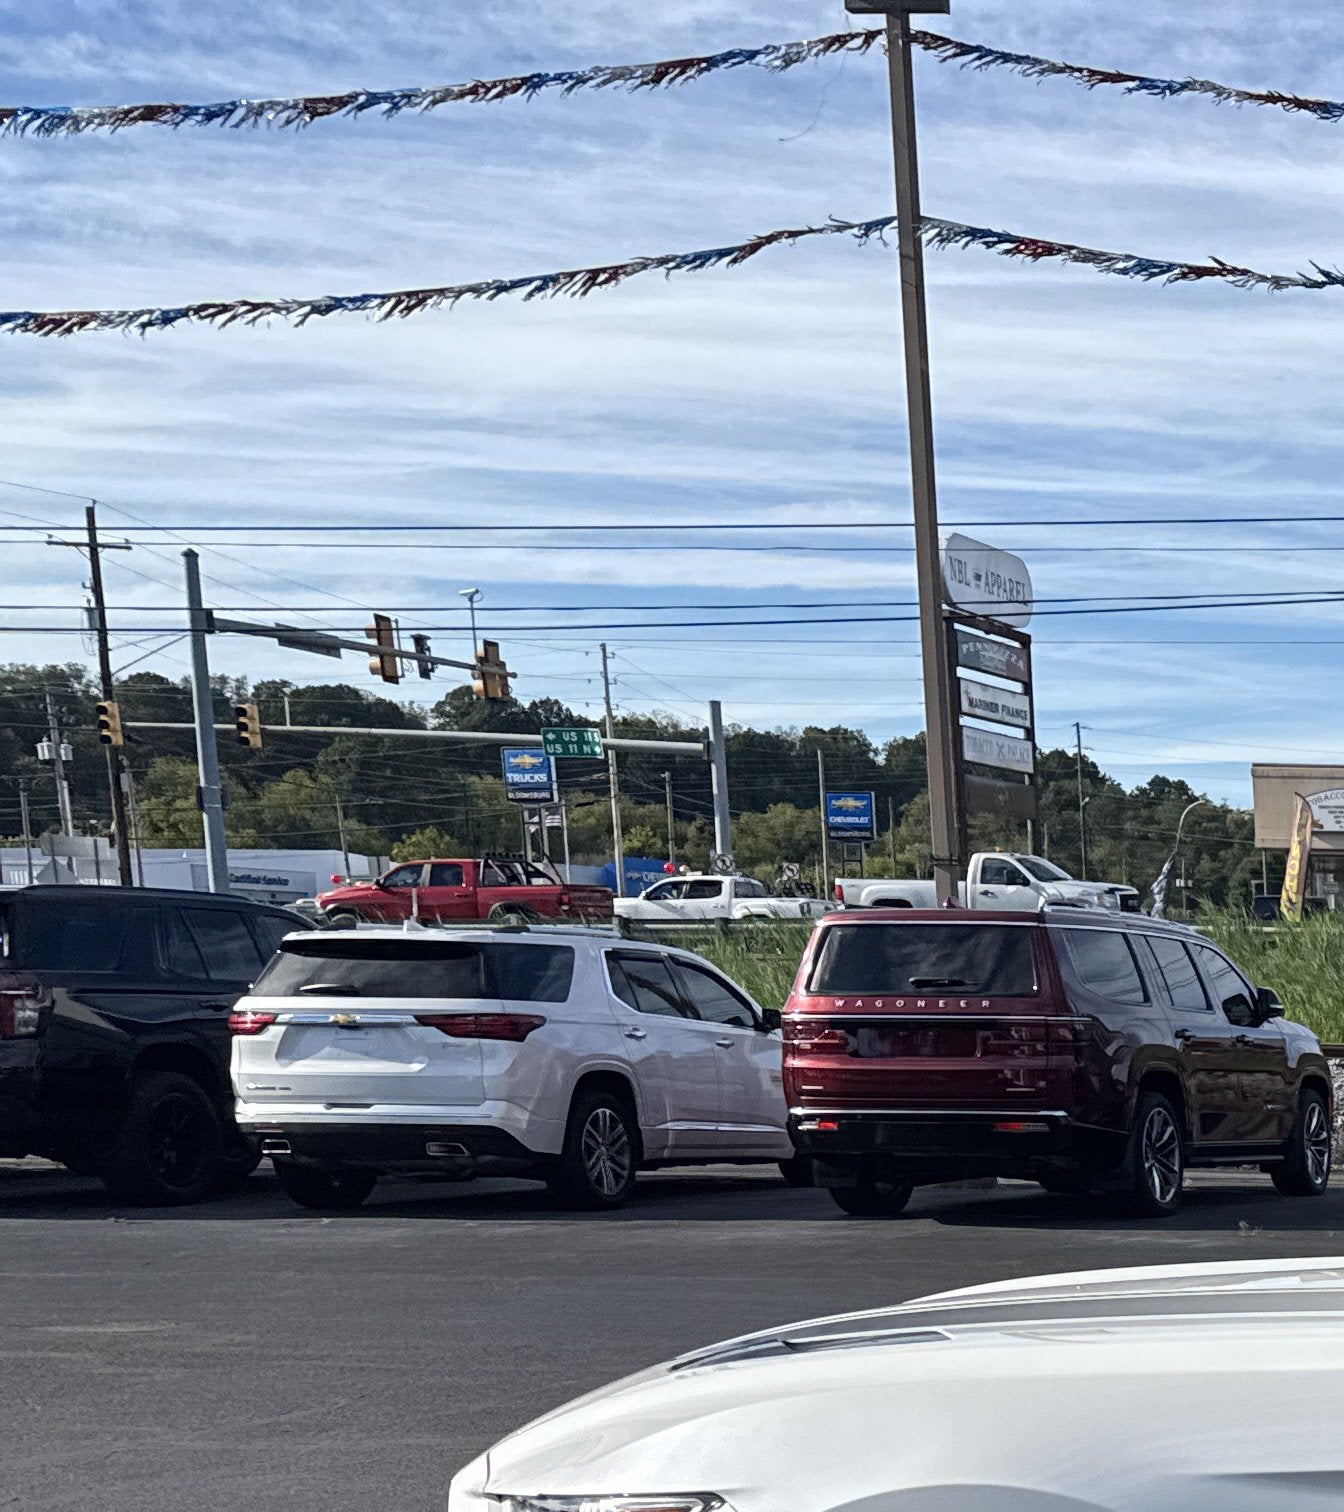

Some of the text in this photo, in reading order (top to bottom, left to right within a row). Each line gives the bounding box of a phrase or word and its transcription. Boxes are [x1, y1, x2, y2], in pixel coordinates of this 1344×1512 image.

[948, 556, 1028, 607] NBL APPAREL
[968, 696, 1028, 721] MARINER FINANCE
[562, 731, 578, 742] US
[546, 743, 592, 754] US 11 N
[506, 773, 548, 783] TRUCKS
[834, 999, 990, 1008] WAGONEER
